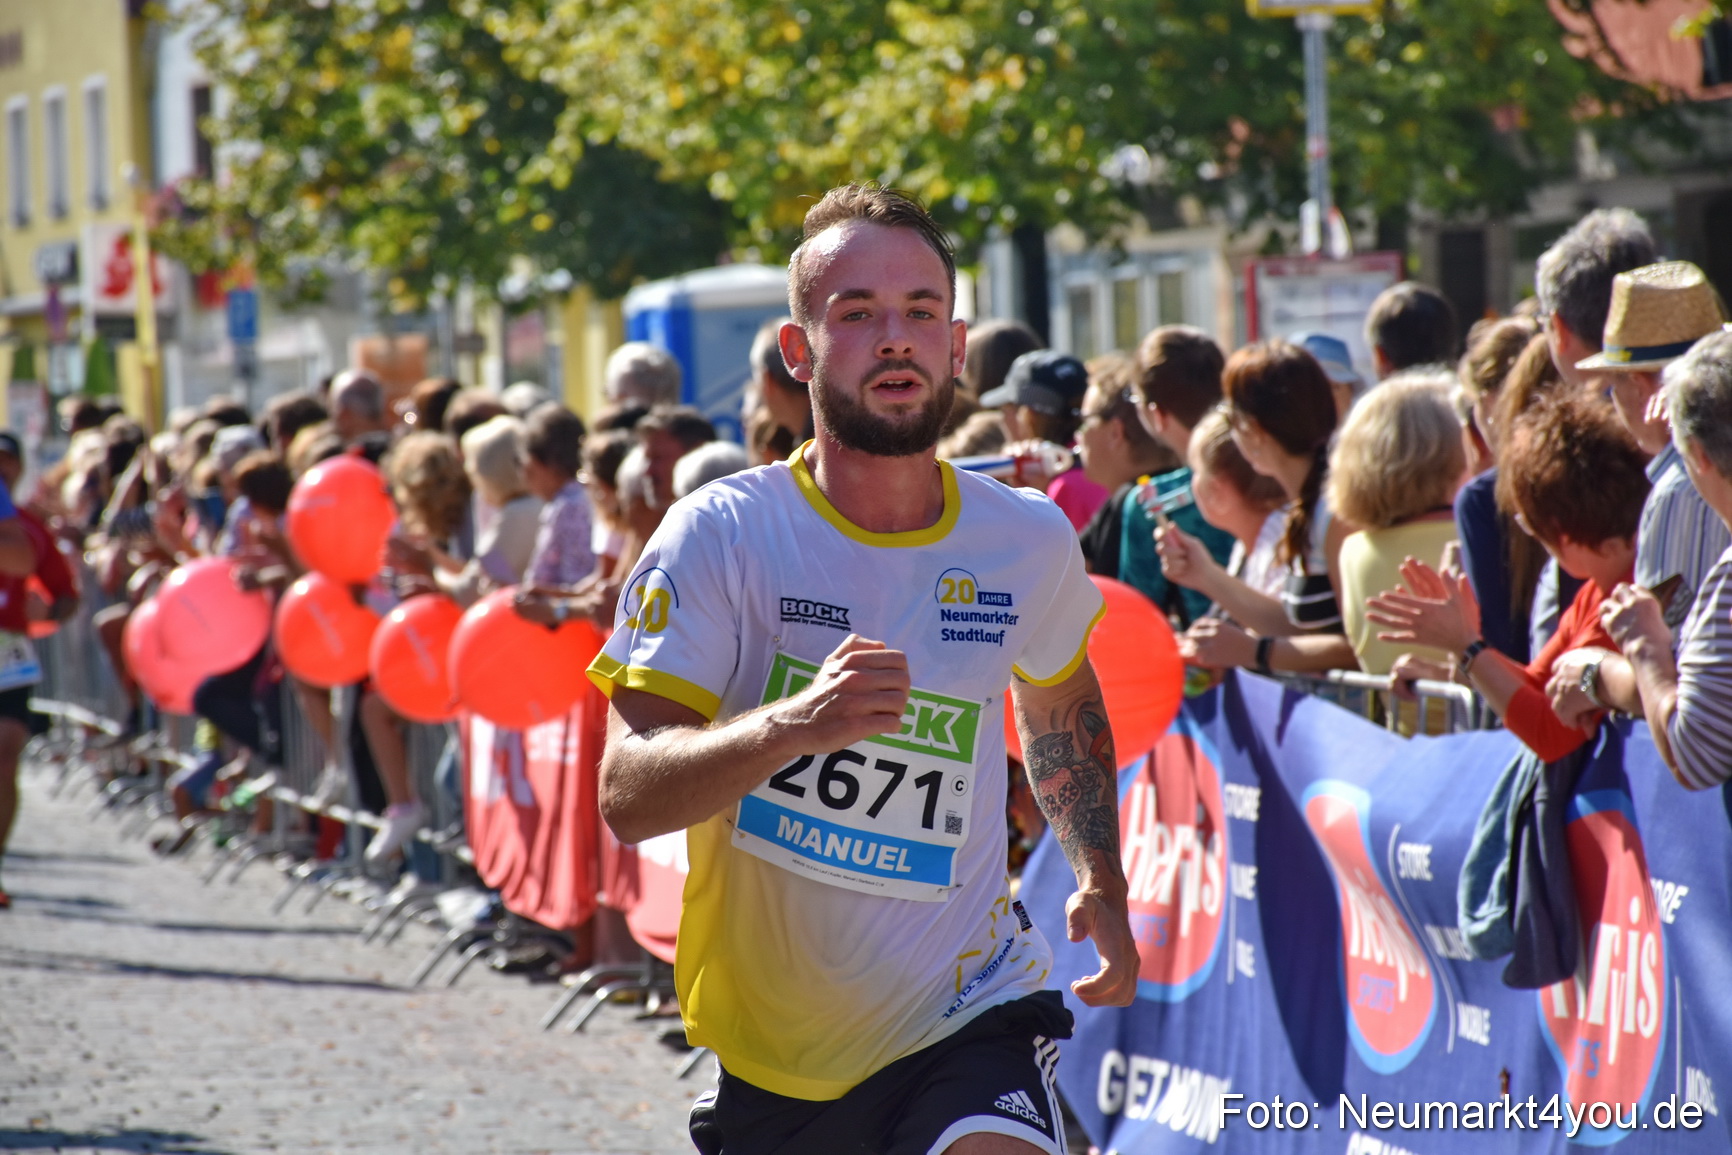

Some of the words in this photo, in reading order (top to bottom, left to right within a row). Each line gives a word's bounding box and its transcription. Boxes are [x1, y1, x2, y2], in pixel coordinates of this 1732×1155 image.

[940, 578, 975, 605] 20
[980, 593, 1009, 605] JAHRE
[781, 597, 850, 625] BOCK
[940, 609, 1019, 625] Neumarkter
[827, 623, 851, 632] concepts
[941, 628, 1006, 647] Stadtlauf
[768, 748, 944, 831] 2671
[776, 814, 912, 873] MANUEL
[1398, 841, 1433, 881] STORE
[1097, 1050, 1170, 1121] GET
[994, 1100, 1046, 1128] adidas
